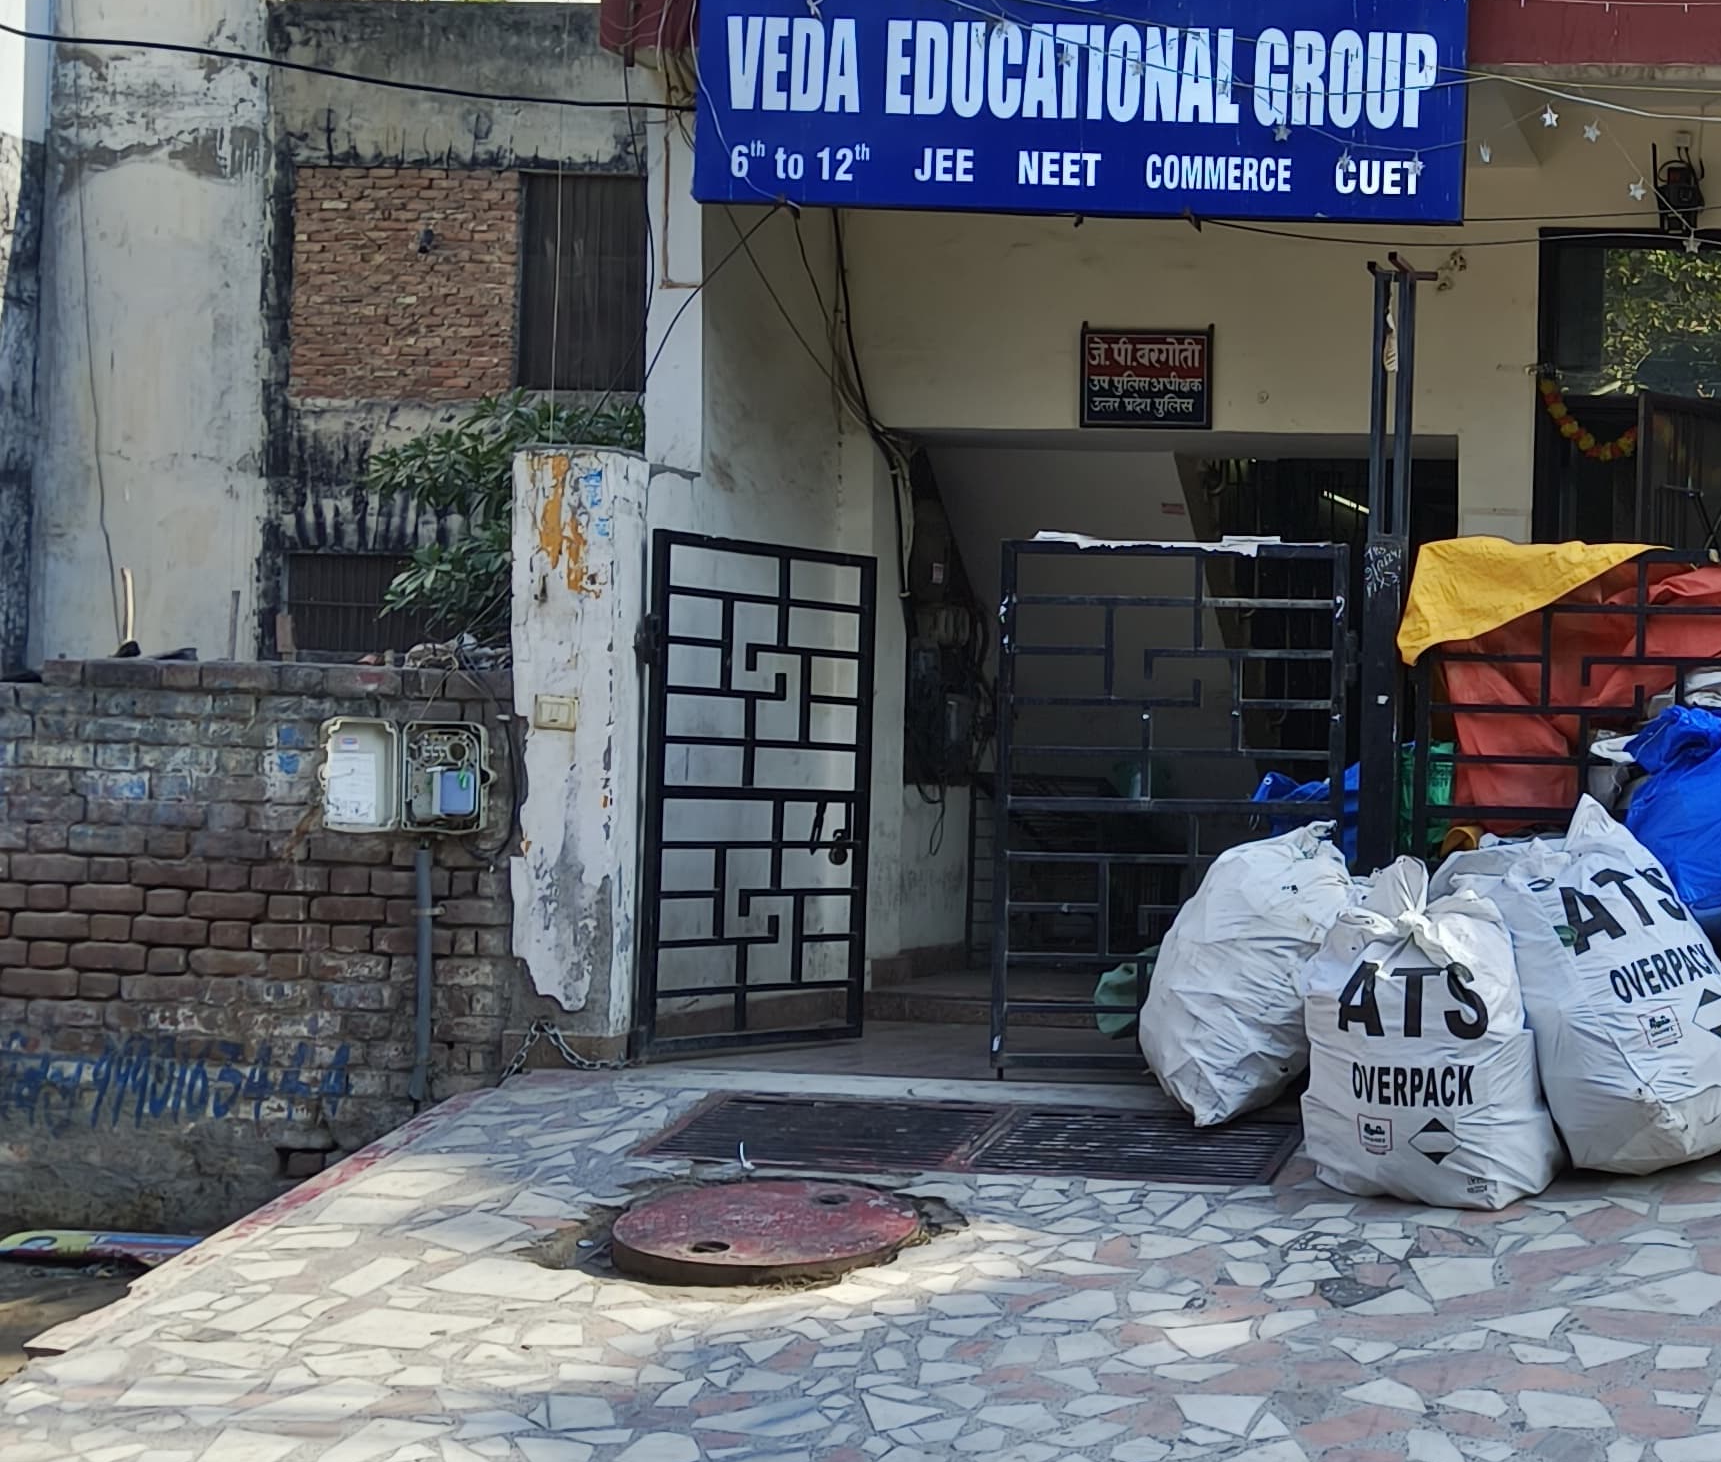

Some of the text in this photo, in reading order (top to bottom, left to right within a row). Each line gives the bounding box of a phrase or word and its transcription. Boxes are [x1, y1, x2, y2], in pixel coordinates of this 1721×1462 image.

[726, 16, 1438, 129] VEDA EDUCATIONAL GROUP
[730, 140, 1420, 195] 6th to 12th JEE NEET COMMERCE CUET
[1089, 375, 1109, 392] उप
[1112, 371, 1149, 395] पुलिस
[1090, 396, 1120, 413] उत्तर
[1154, 394, 1194, 417] पुलिस
[1559, 868, 1687, 956] ATS
[1338, 961, 1489, 1040] ATS
[1609, 943, 1720, 1004] OVERPACK
[1352, 1062, 1475, 1107] OVERPACK
